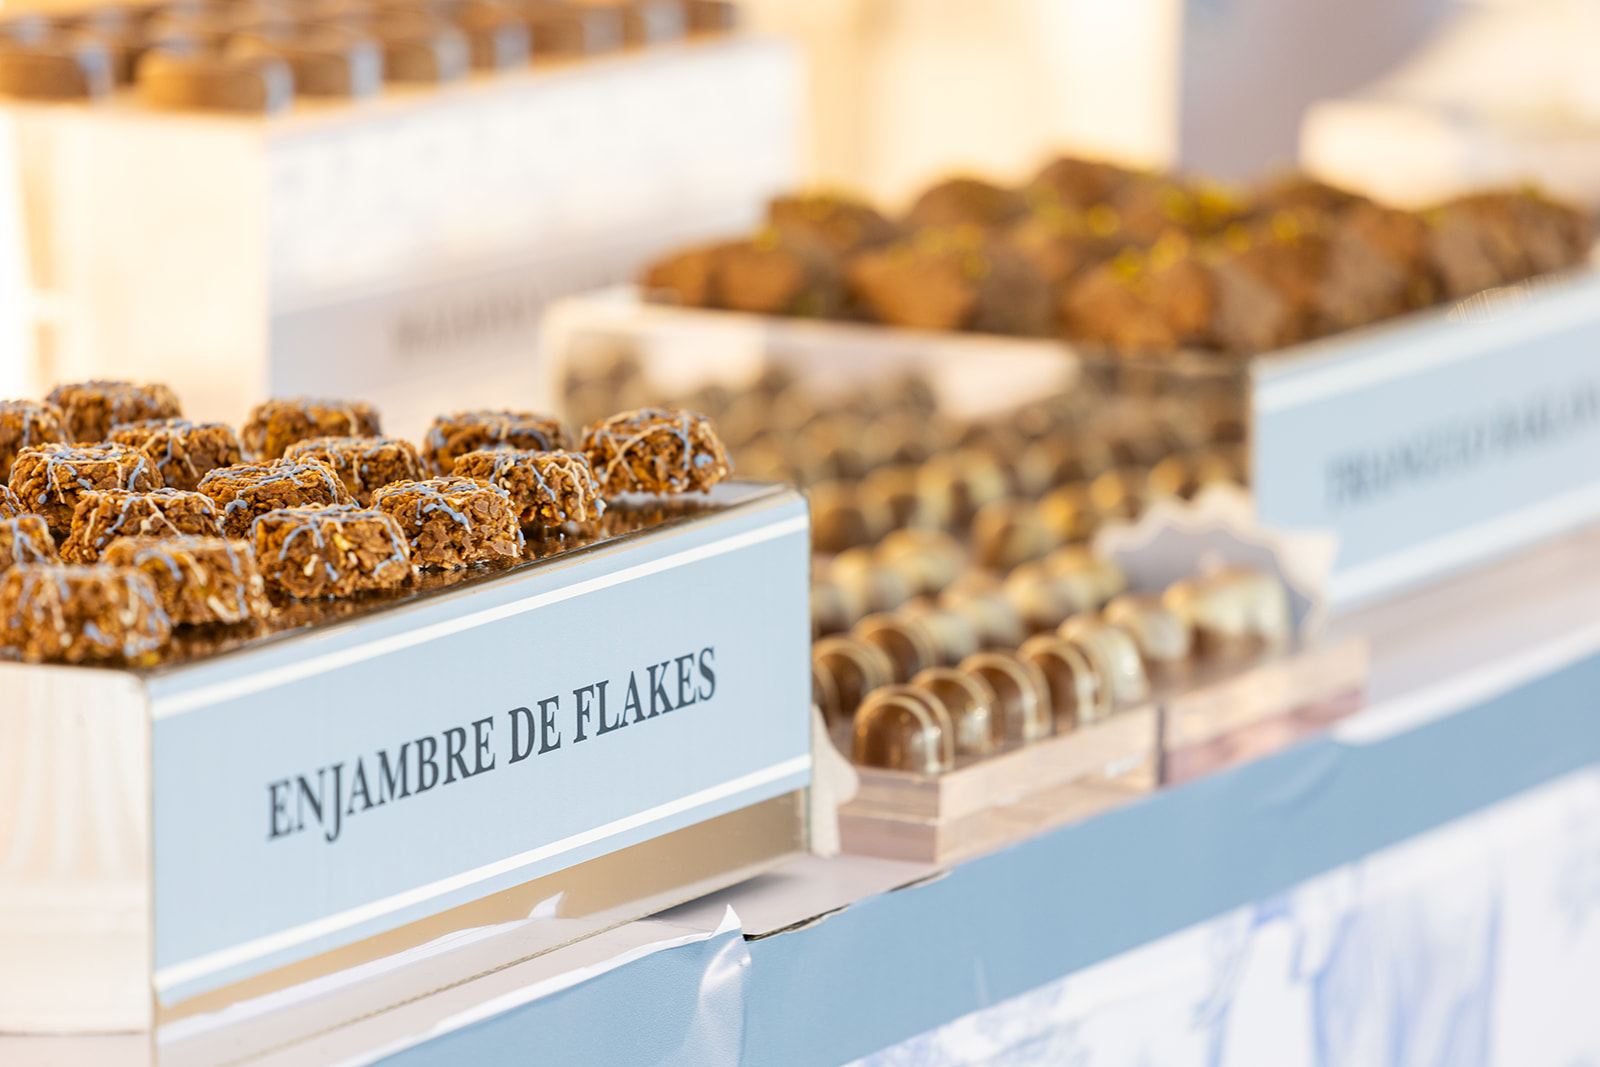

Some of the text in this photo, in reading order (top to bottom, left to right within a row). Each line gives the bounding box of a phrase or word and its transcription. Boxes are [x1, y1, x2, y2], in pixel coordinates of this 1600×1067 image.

[267, 646, 717, 842] ENJAMBRE DE FLAKES
